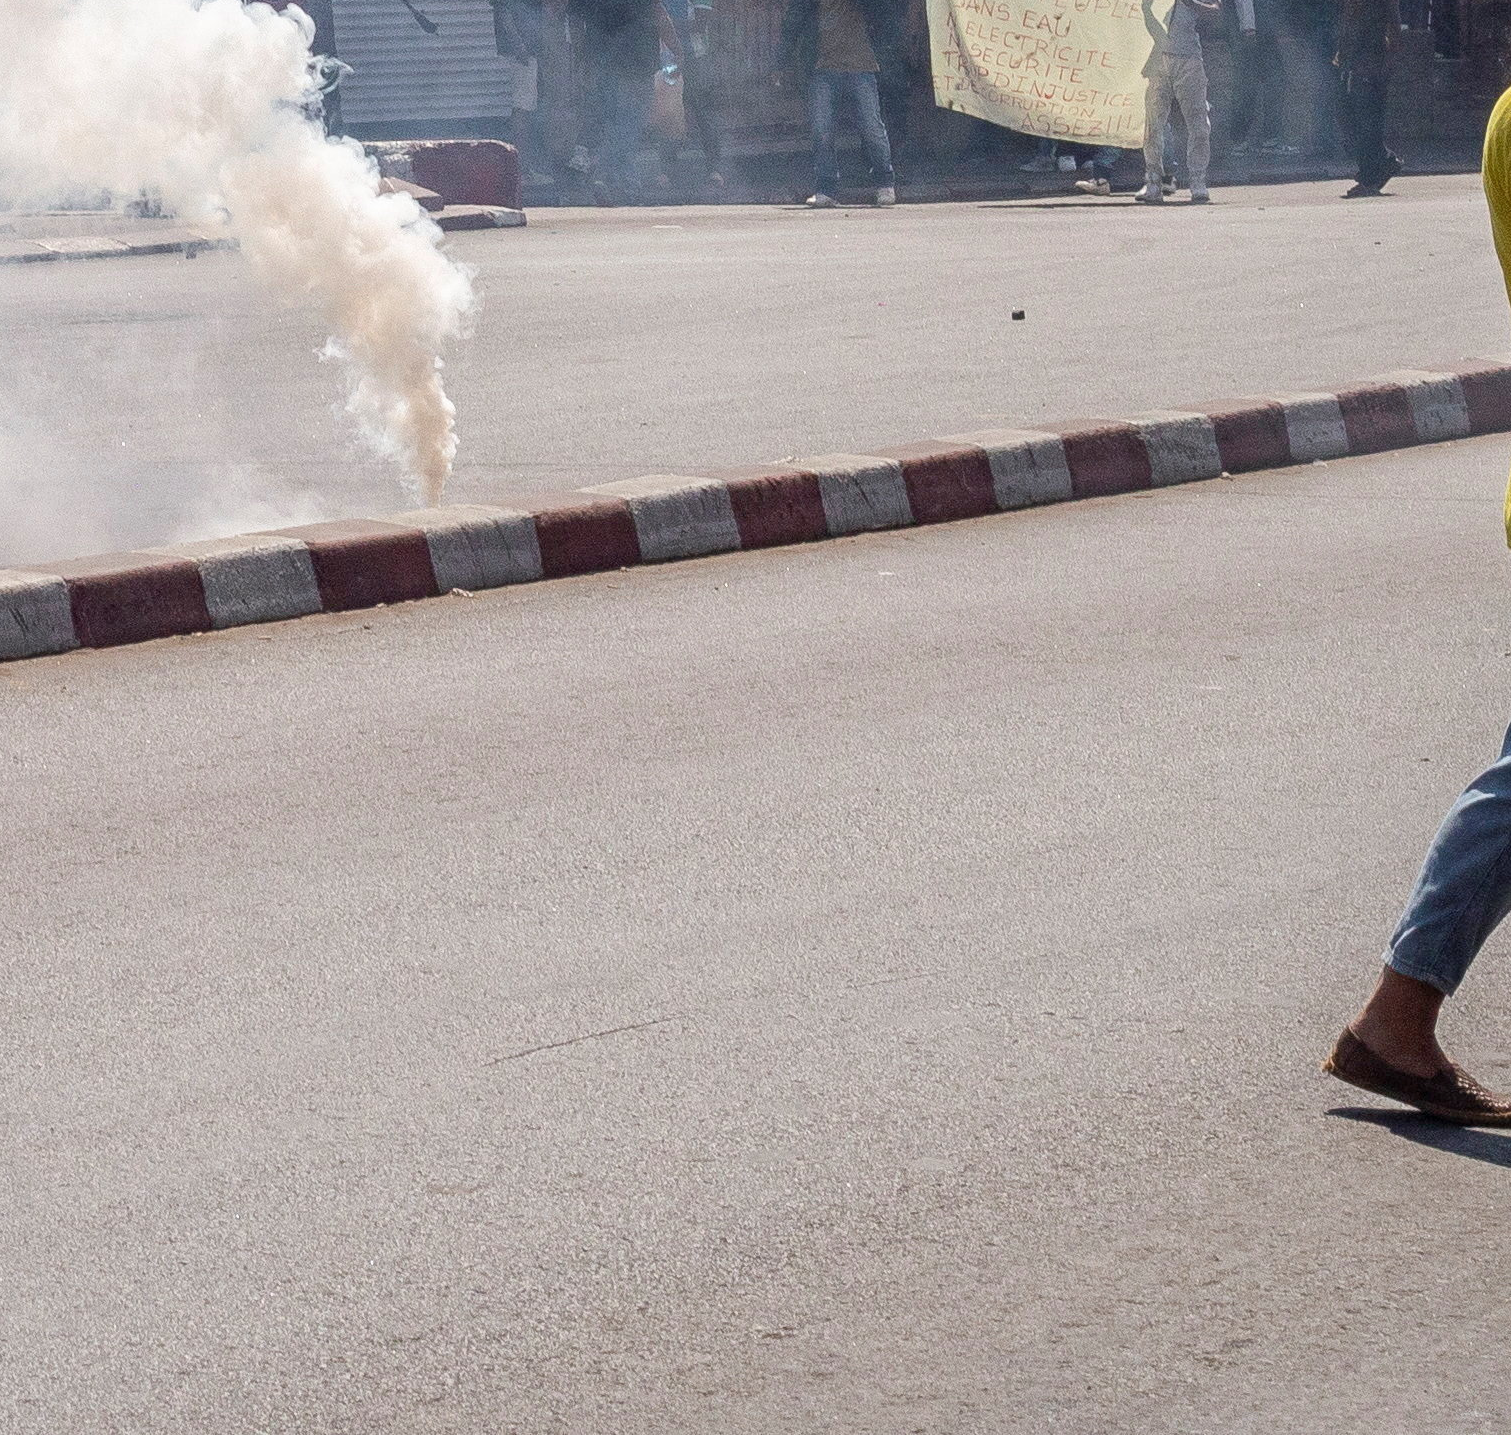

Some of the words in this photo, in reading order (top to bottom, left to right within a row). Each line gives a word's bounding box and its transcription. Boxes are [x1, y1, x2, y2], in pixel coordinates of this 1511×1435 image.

[1022, 12, 1073, 38] EAU
[965, 20, 1117, 69] ELECTRICITE
[970, 43, 1085, 84] SECURITE
[992, 71, 1135, 107] D'INJUSTICE
